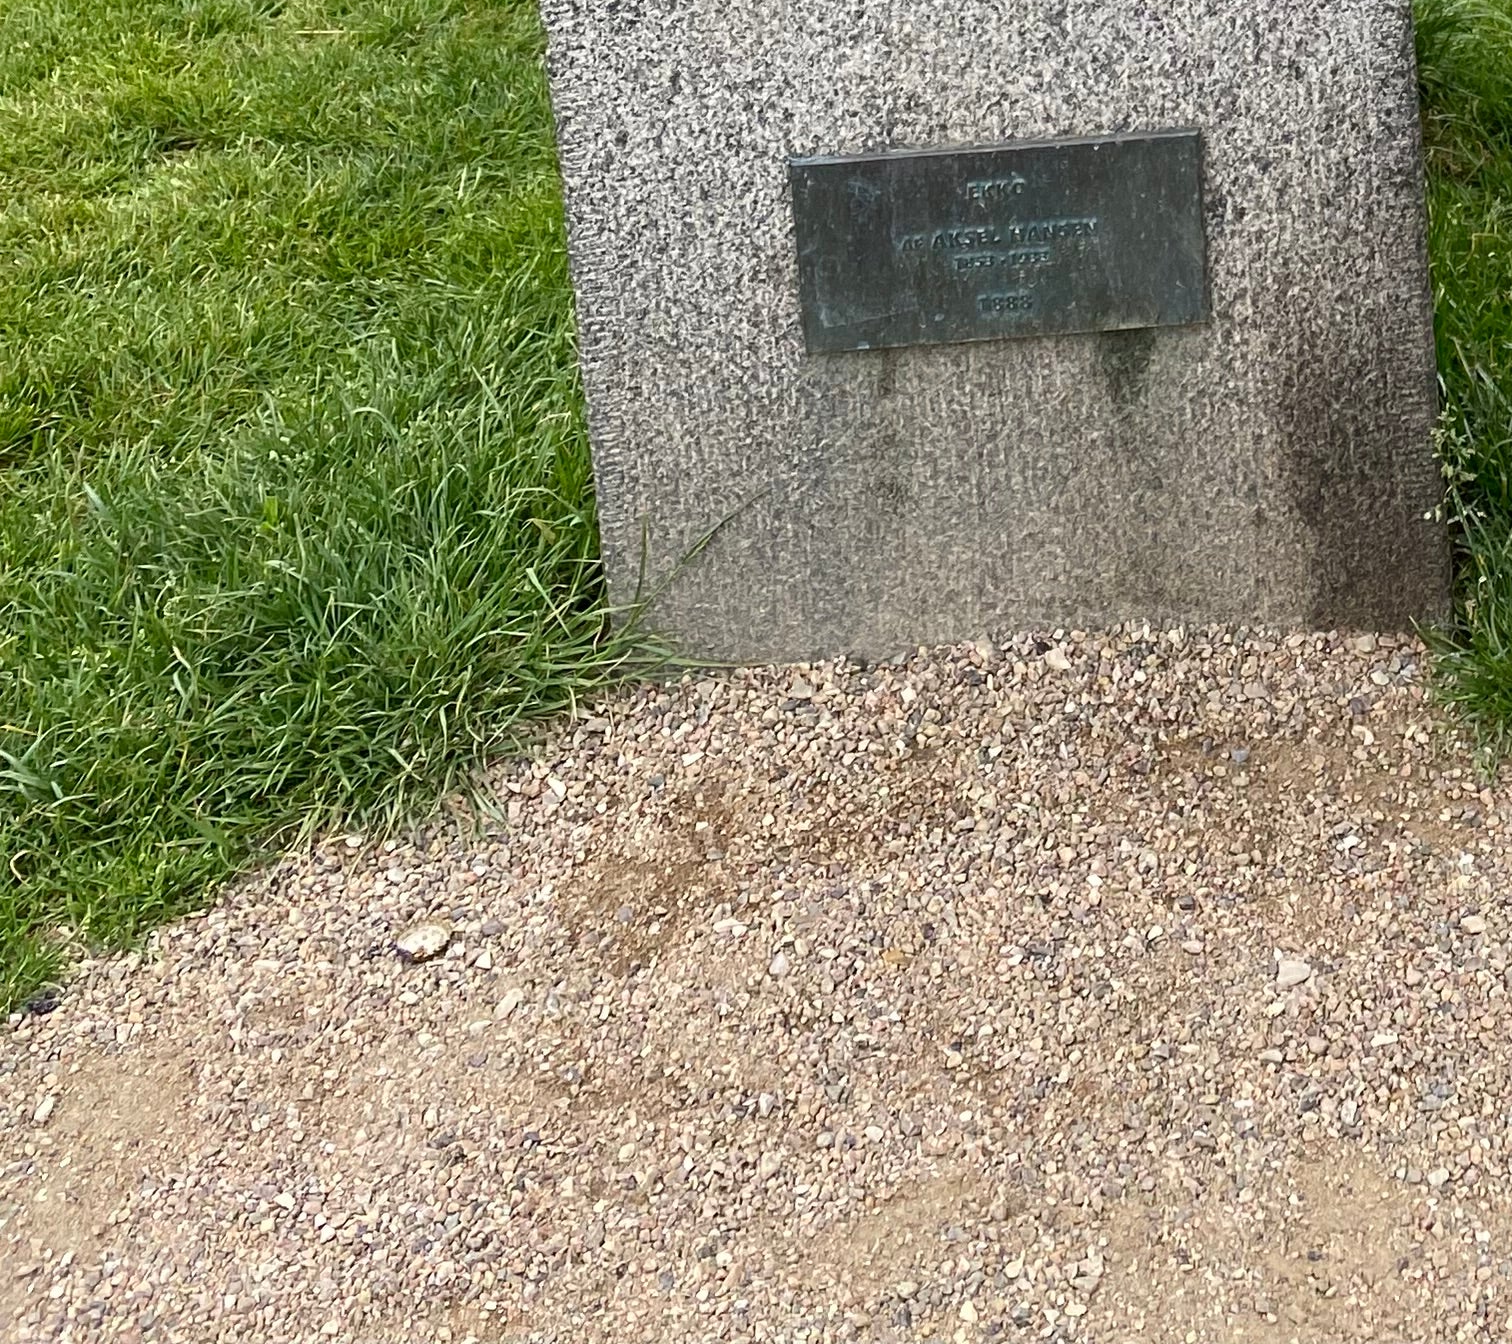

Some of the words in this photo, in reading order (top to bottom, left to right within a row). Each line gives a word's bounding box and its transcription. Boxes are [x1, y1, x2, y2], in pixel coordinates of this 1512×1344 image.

[967, 178, 1026, 198] EKKO
[931, 227, 1001, 251] AKSEL
[1008, 218, 1097, 243] HANSEN
